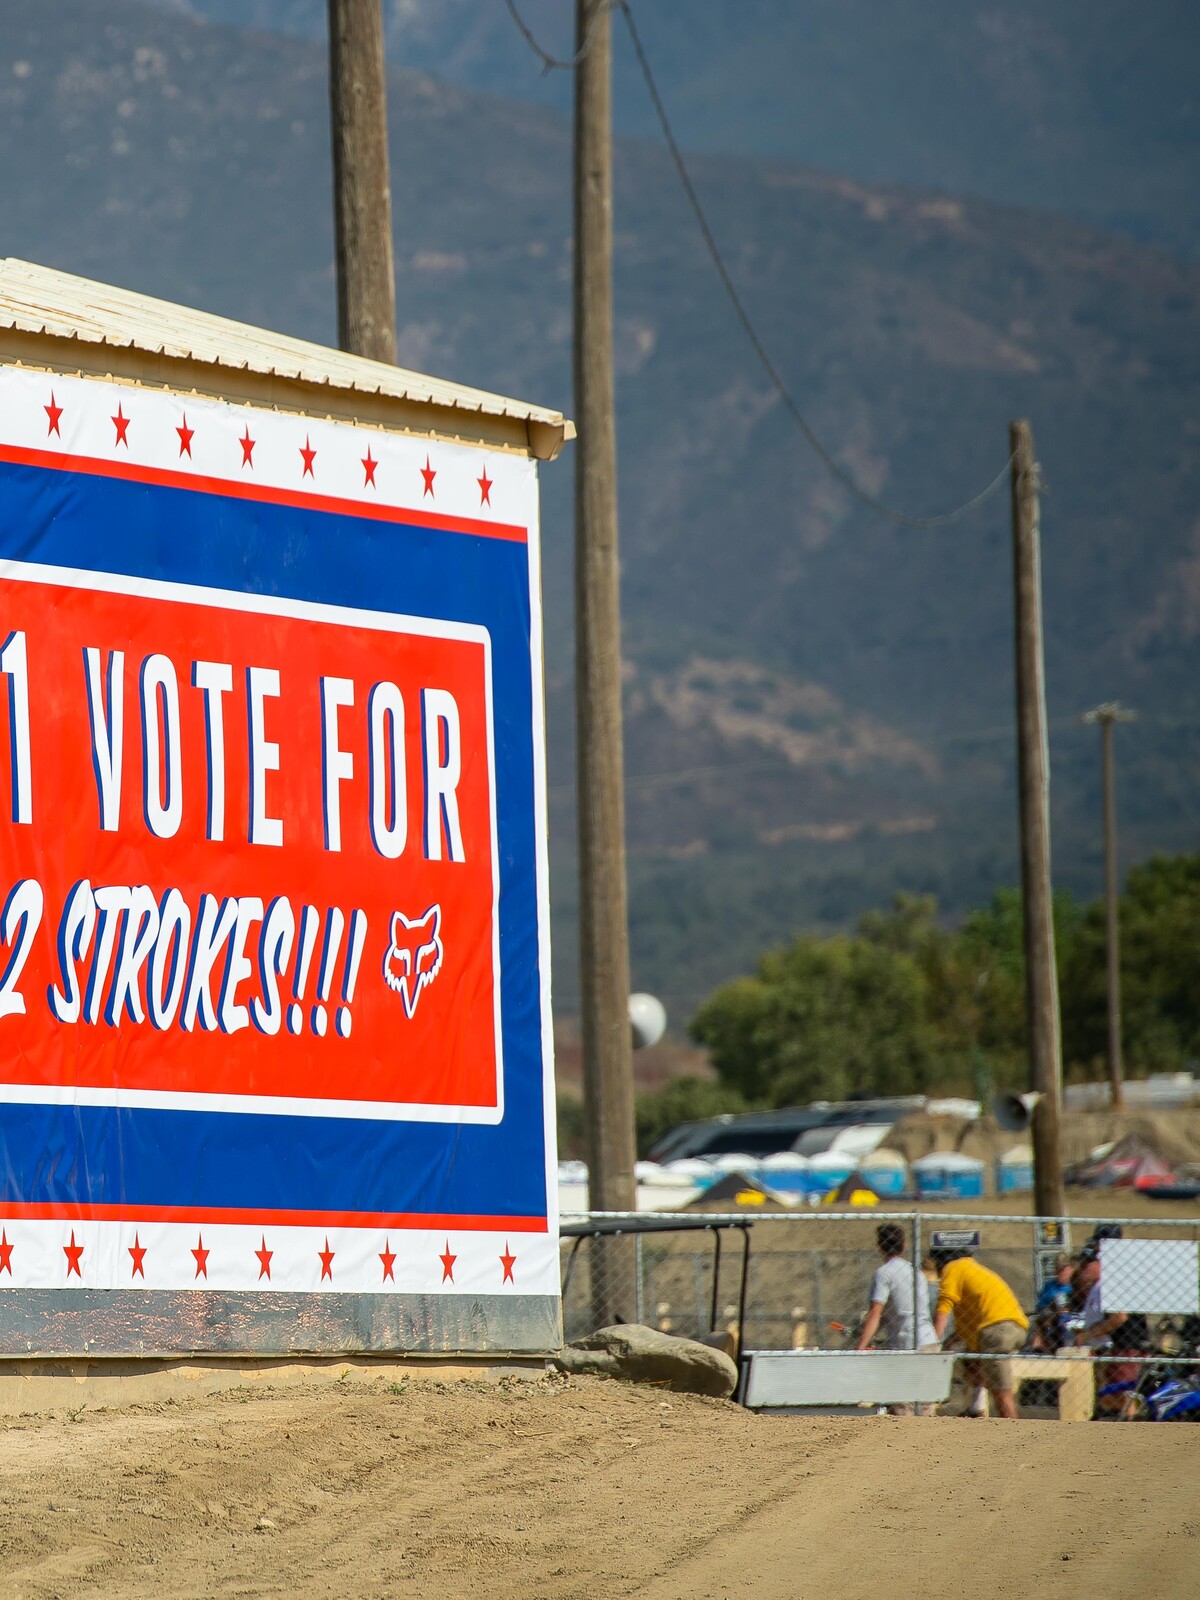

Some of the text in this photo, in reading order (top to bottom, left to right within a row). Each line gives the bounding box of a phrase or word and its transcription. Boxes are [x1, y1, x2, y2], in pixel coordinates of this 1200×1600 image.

[82, 646, 284, 847] VOTE
[319, 676, 466, 863] FOR
[47, 878, 368, 1039] STROKES!!!
